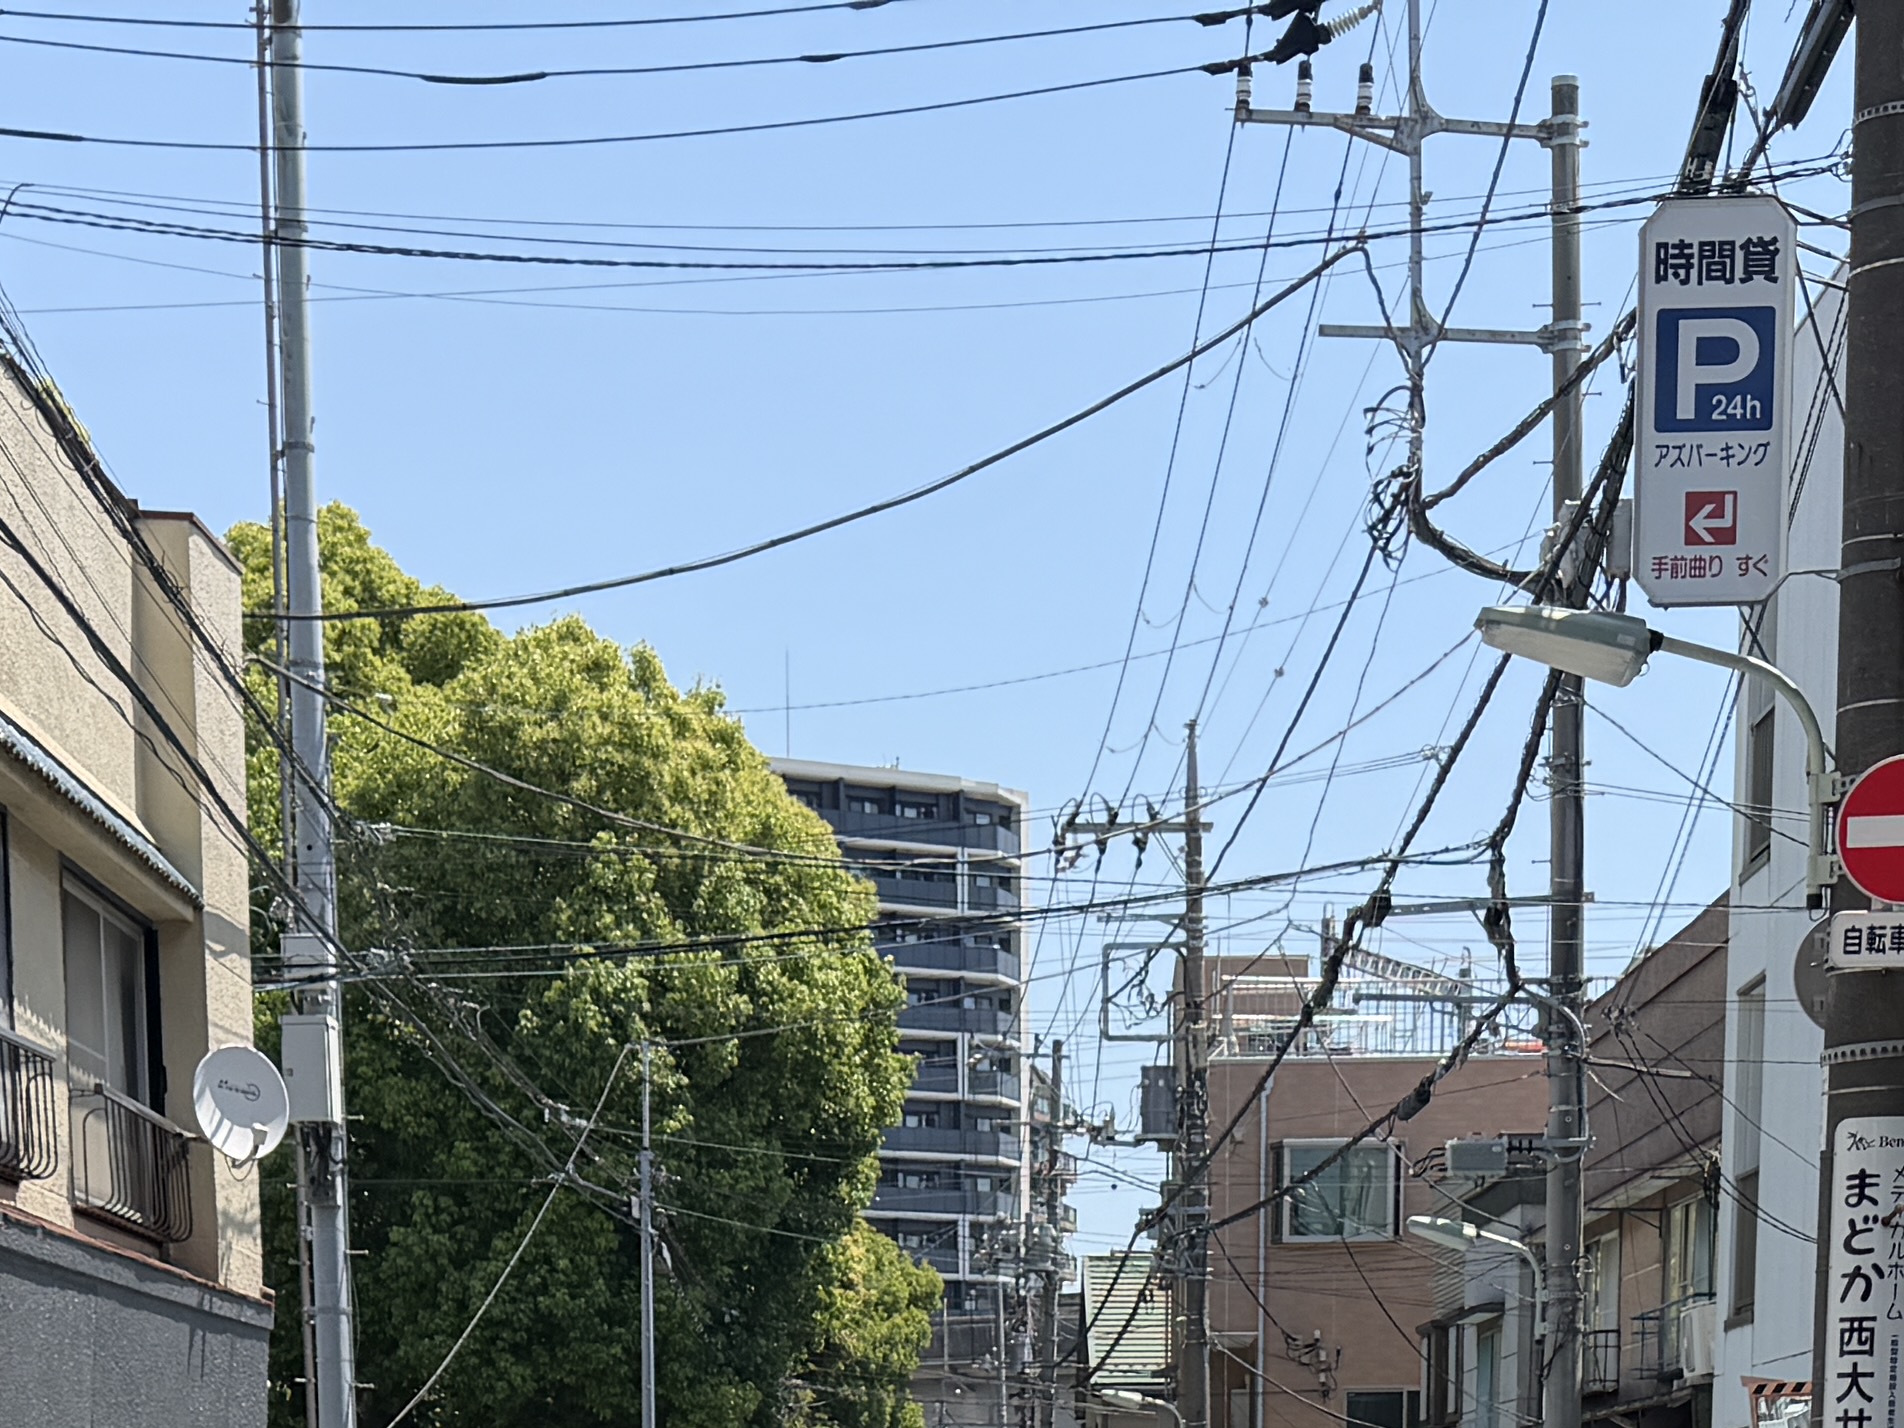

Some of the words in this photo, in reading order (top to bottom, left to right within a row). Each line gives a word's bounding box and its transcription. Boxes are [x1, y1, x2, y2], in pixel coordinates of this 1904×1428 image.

[1654, 235, 1781, 286] 時間貸
[1676, 318, 1760, 420] P
[1711, 394, 1762, 420] 24h
[1650, 554, 1724, 580] 手前曲り
[1735, 553, 1769, 577] すぐ
